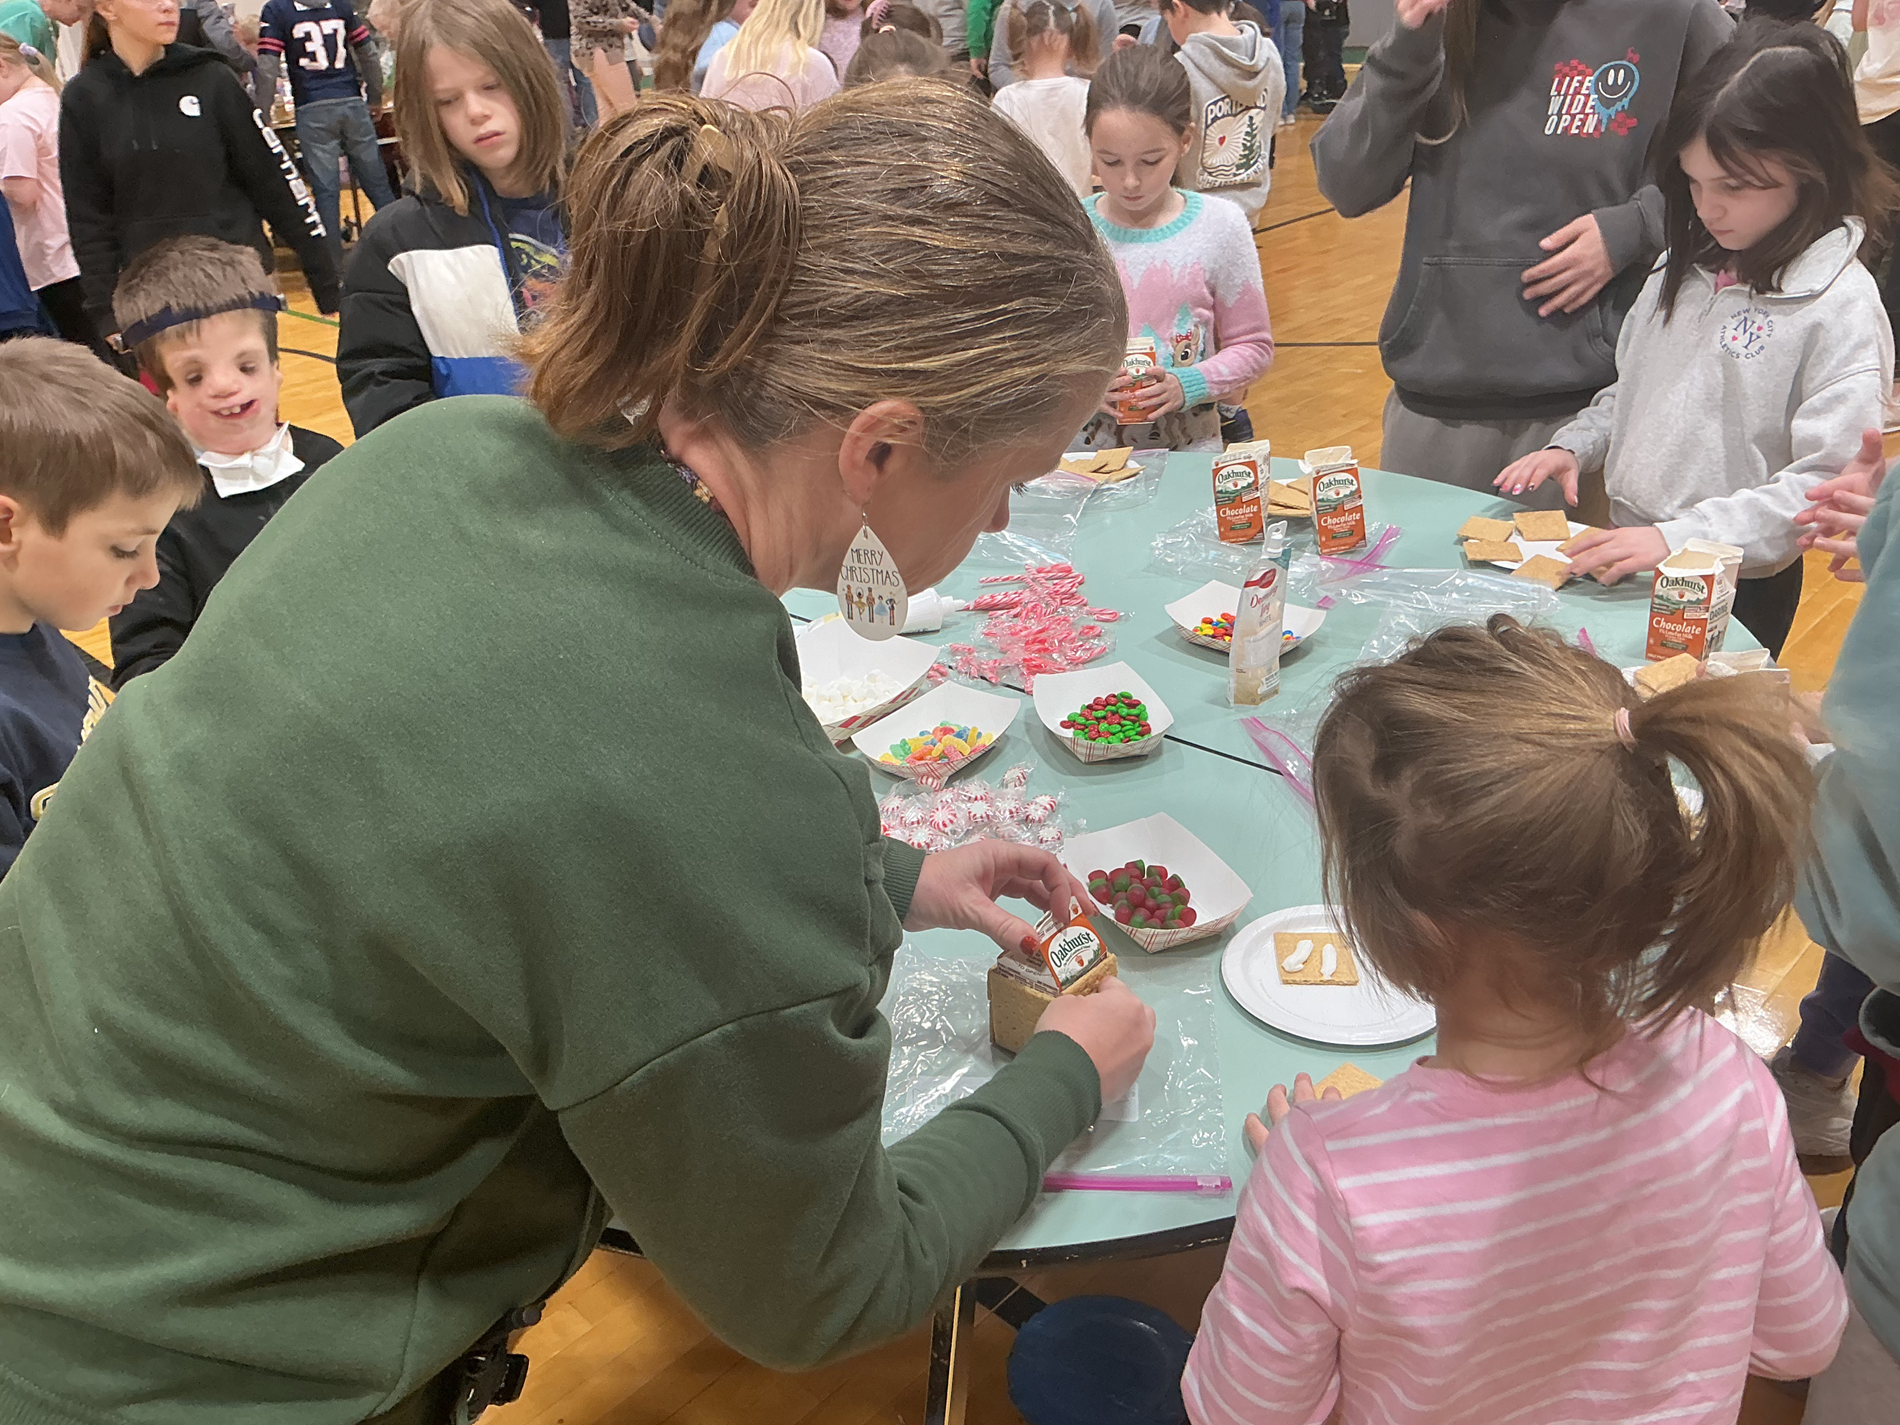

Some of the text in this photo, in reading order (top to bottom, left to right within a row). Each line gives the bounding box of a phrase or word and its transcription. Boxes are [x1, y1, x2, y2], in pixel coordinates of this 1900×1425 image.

[292, 18, 346, 71] 37
[1550, 76, 1594, 96] LIFE
[1548, 94, 1598, 115] WIDE
[1544, 114, 1598, 135] OPEN
[1730, 307, 1774, 338] NEW YORK CITY
[1720, 325, 1765, 360] ATHLETICS CLUB
[1217, 468, 1253, 484] Oakhurst
[1318, 477, 1356, 492] Oakhurst
[1220, 504, 1259, 518] Chocolate
[1321, 512, 1361, 526] Chocolate
[850, 548, 884, 566] MERRY
[840, 564, 900, 588] CHRISTMAS
[1660, 576, 1705, 594] Oakhurst
[1652, 617, 1702, 635] Chocolate
[1050, 931, 1094, 967] Oakhurst
[1025, 968, 1041, 976] OPEN
